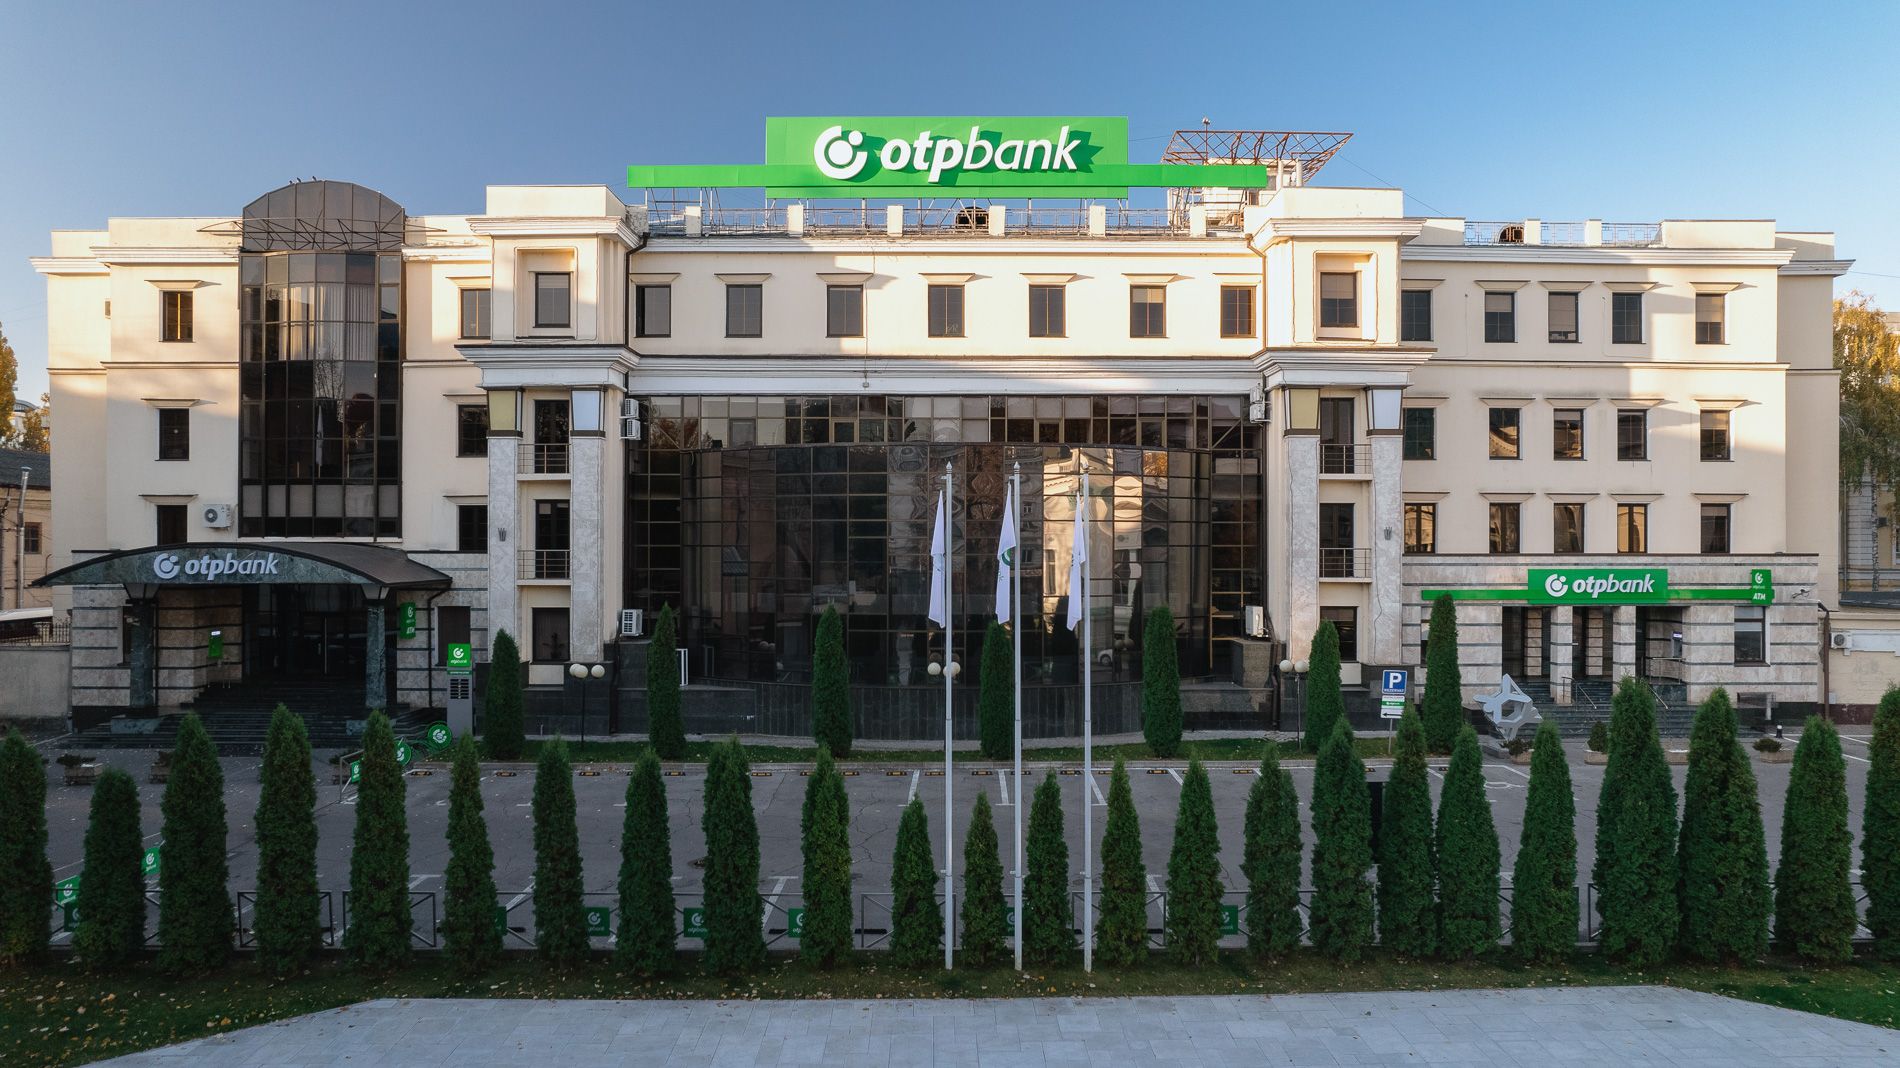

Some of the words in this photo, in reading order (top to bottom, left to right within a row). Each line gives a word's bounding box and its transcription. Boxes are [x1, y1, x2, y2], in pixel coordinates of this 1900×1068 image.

[880, 125, 1081, 184] otpbank
[184, 553, 278, 580] otpbank
[1572, 574, 1655, 598] otpbank
[1389, 673, 1402, 688] P
